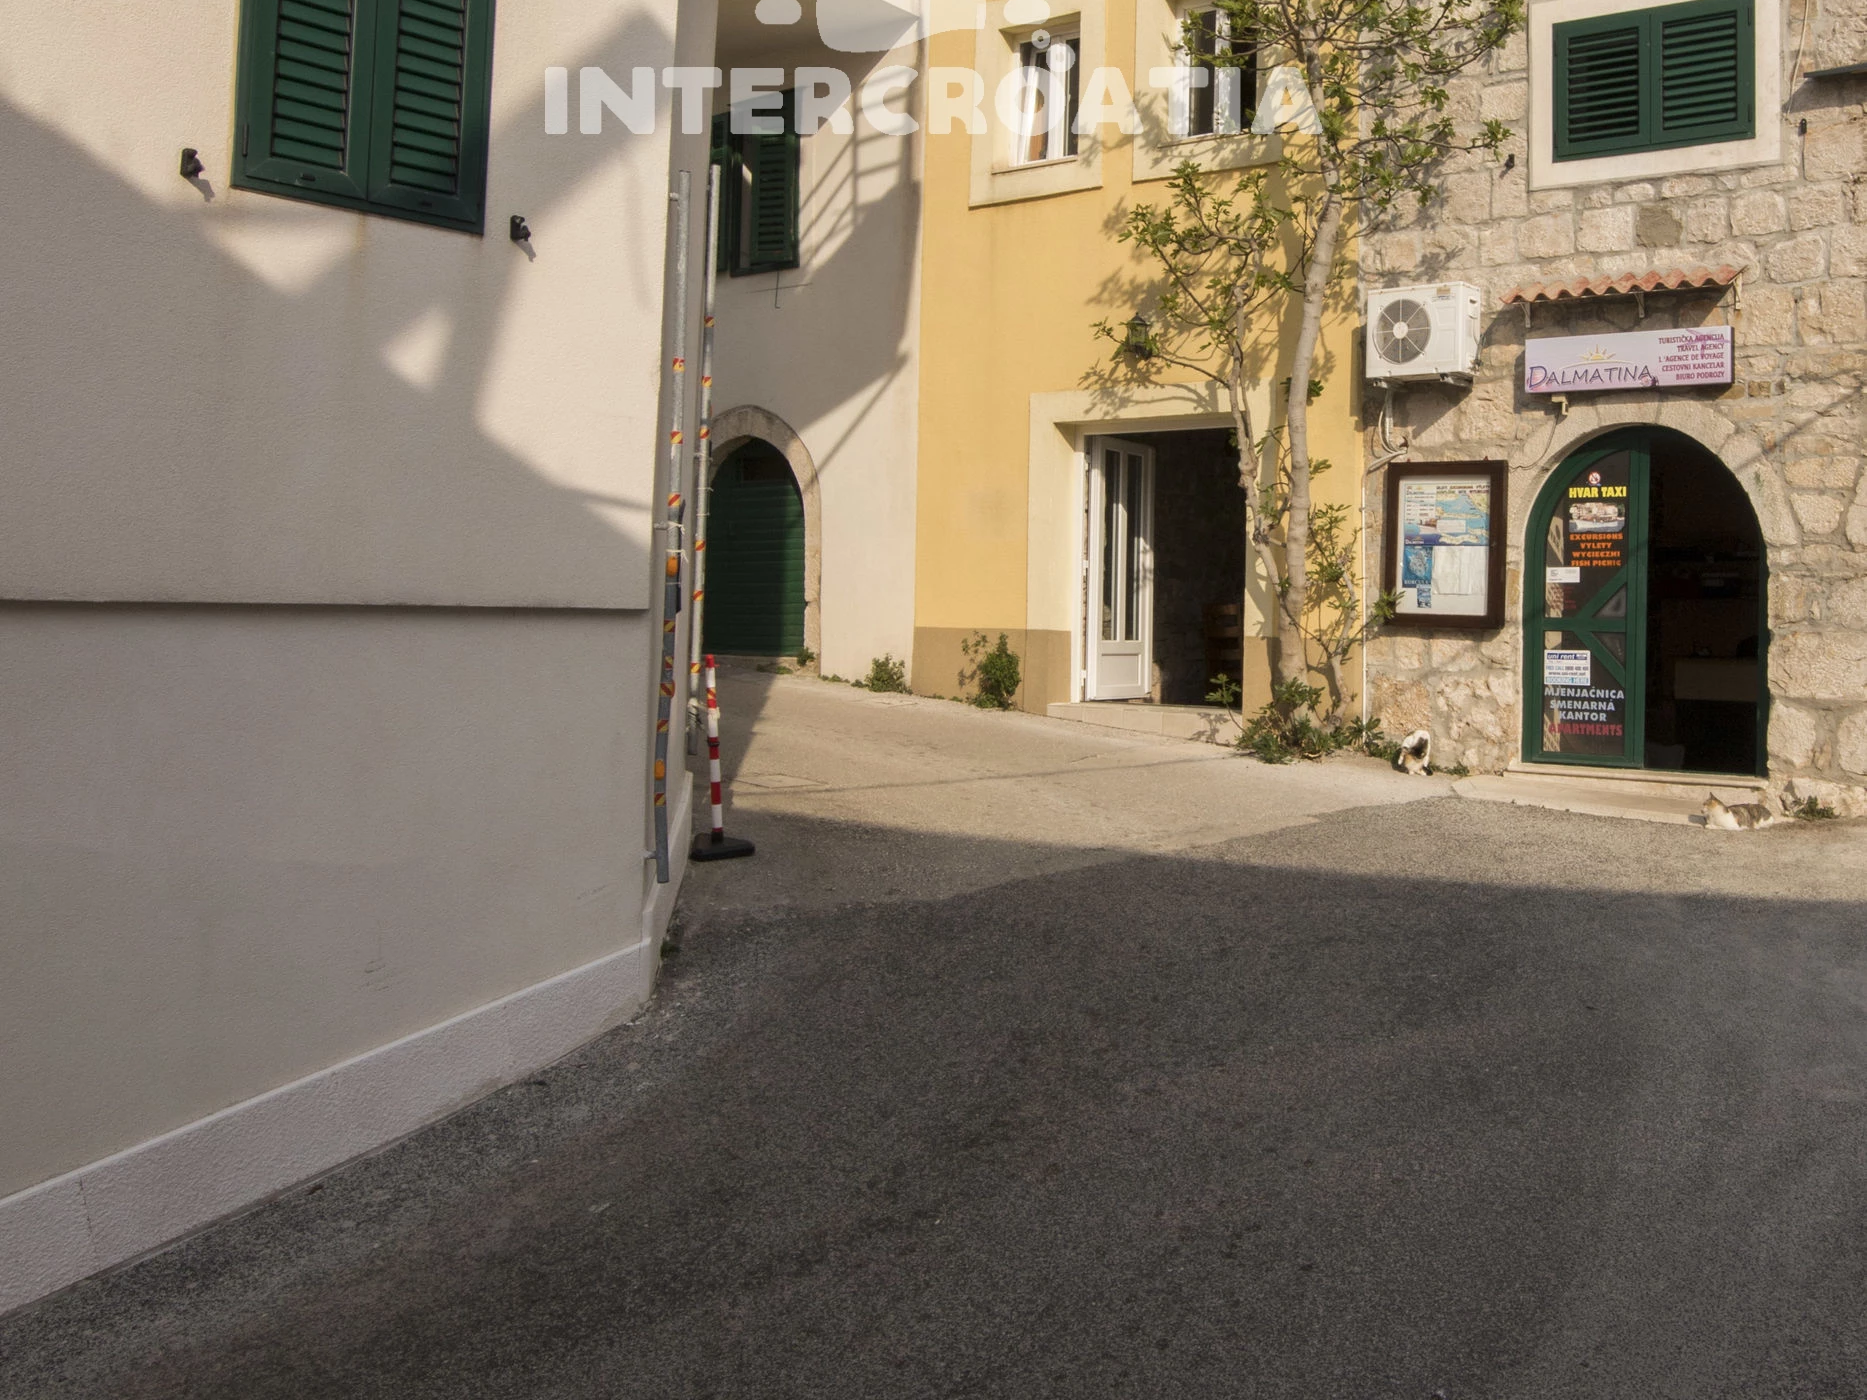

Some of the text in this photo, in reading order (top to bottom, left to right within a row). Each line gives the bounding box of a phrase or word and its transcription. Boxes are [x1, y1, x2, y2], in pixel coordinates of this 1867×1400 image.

[1677, 342, 1724, 352] TRAVEL AGENCY
[1701, 352, 1724, 360] VOYAGE
[1528, 364, 1652, 390] DALMATINA
[1676, 372, 1695, 380] BIURO
[1569, 486, 1627, 498] HVAR TAXI
[1569, 532, 1624, 540] EXCURSIONS
[1571, 559, 1590, 567] FISH
[1544, 686, 1624, 699] MJENJAČNICA
[1559, 711, 1607, 722] KANTOR
[1548, 722, 1624, 736] APARTMENTS
